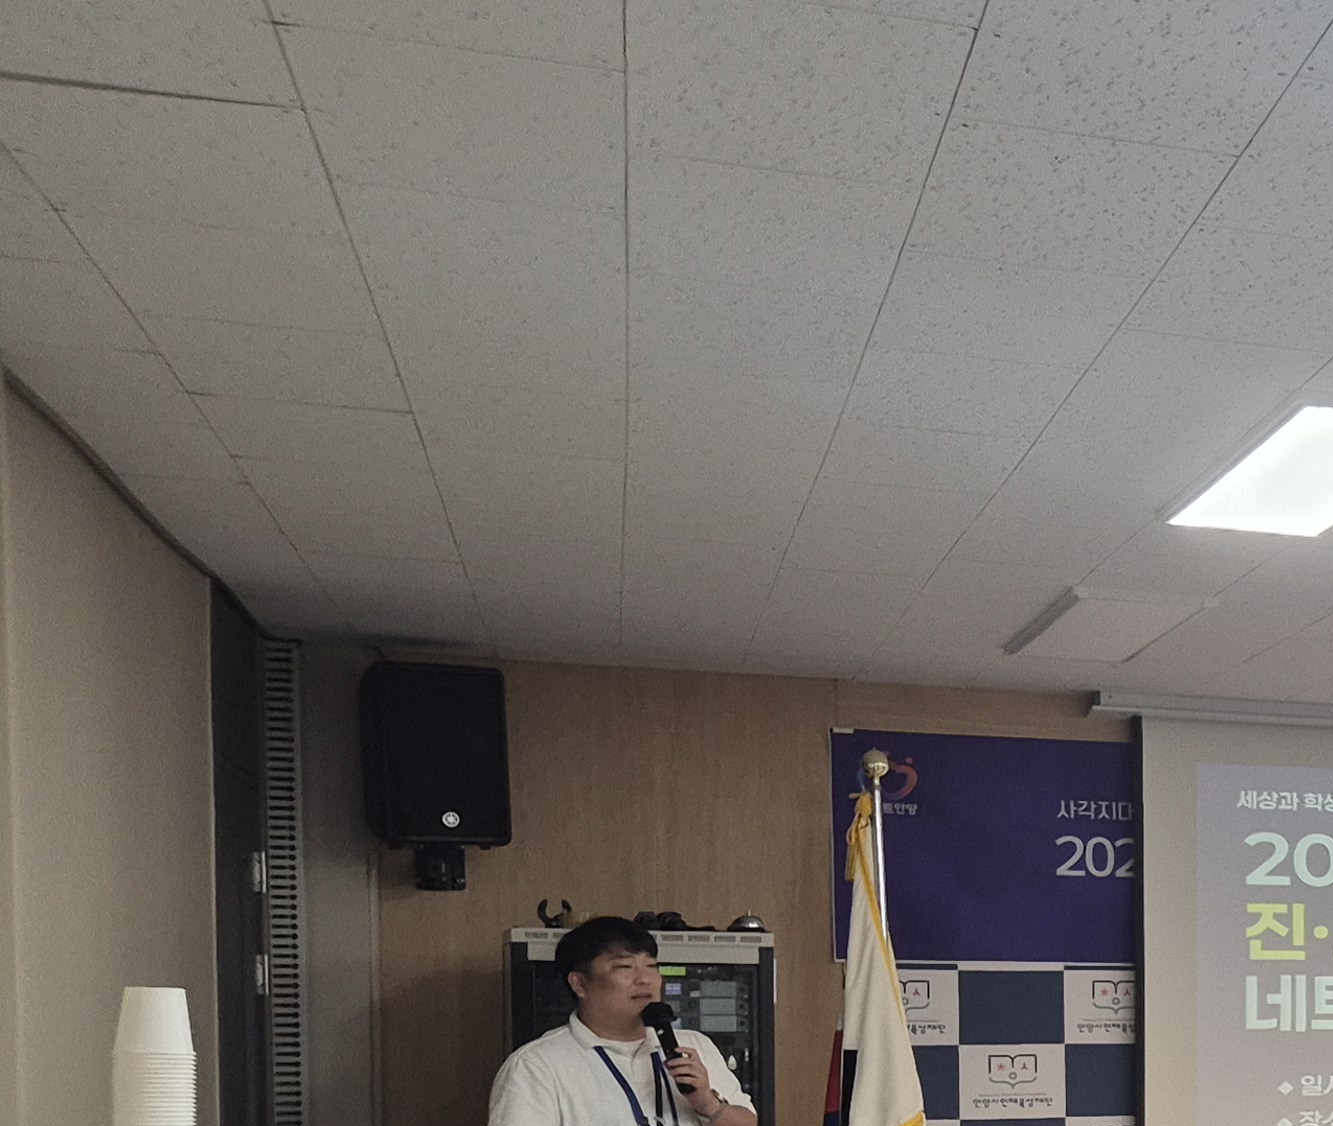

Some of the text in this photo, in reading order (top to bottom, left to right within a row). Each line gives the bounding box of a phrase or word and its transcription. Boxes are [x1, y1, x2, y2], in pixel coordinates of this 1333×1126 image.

[882, 802, 918, 816] 트안양
[1237, 791, 1299, 811] 세상과
[1055, 835, 1135, 877] 202
